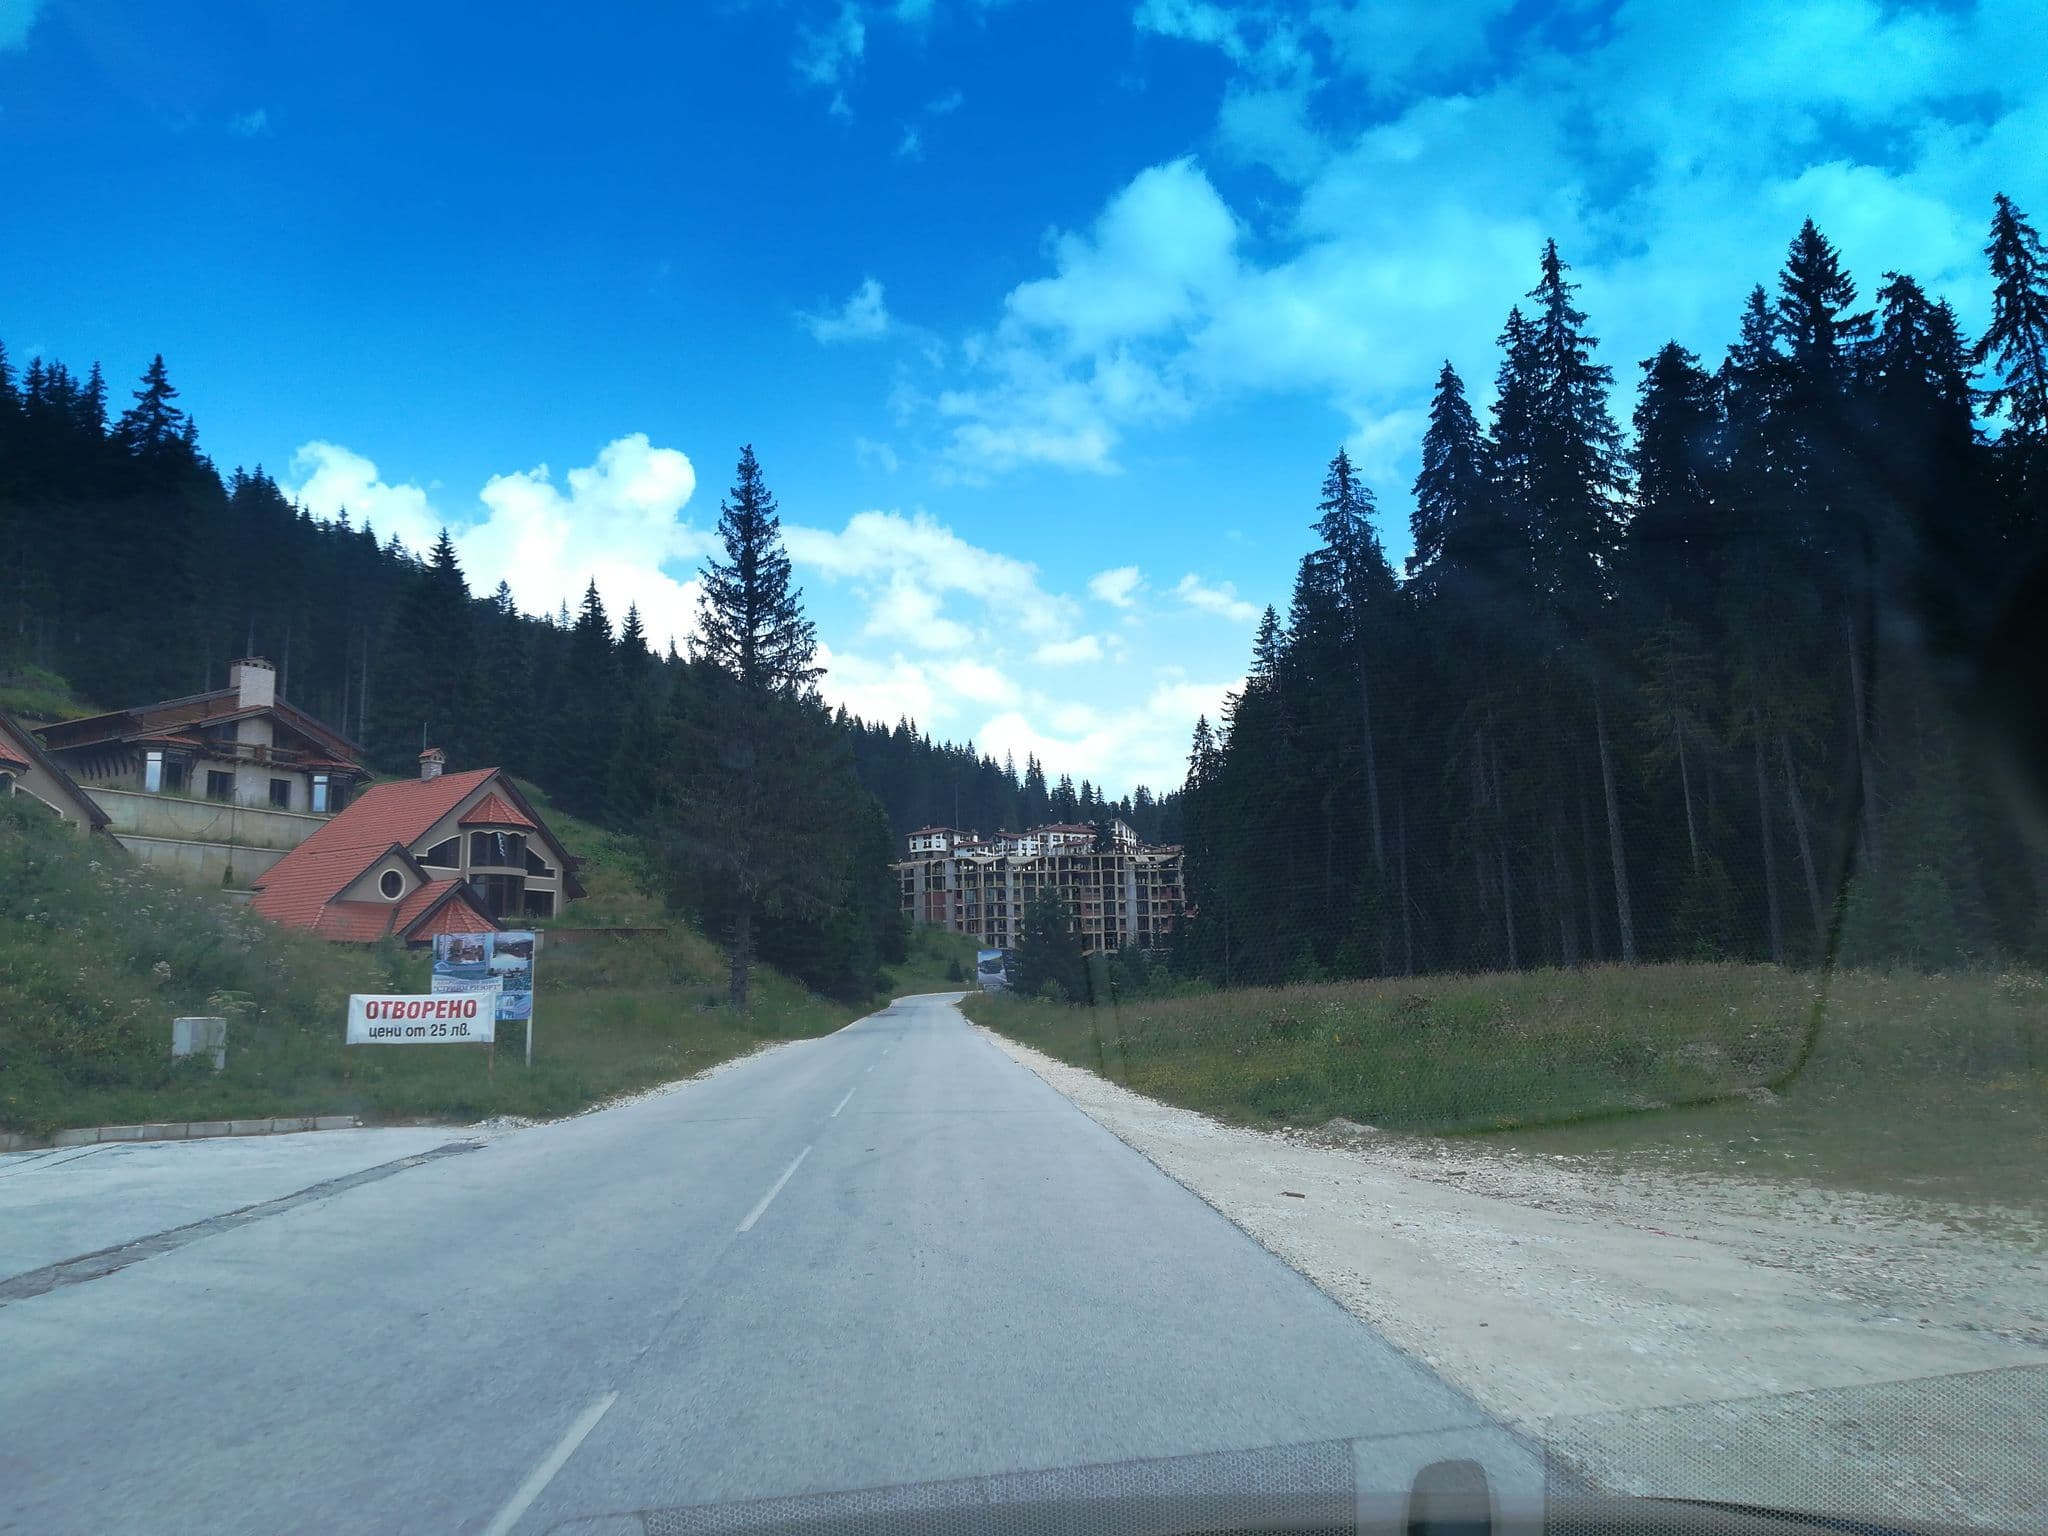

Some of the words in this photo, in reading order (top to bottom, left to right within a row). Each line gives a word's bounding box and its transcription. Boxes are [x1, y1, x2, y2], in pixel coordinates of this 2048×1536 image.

[366, 1000, 477, 1019] ОТВОРЕНО
[369, 1026, 401, 1039] цени
[405, 1026, 426, 1037] от
[430, 1024, 447, 1037] 25
[450, 1023, 471, 1036] лв.
